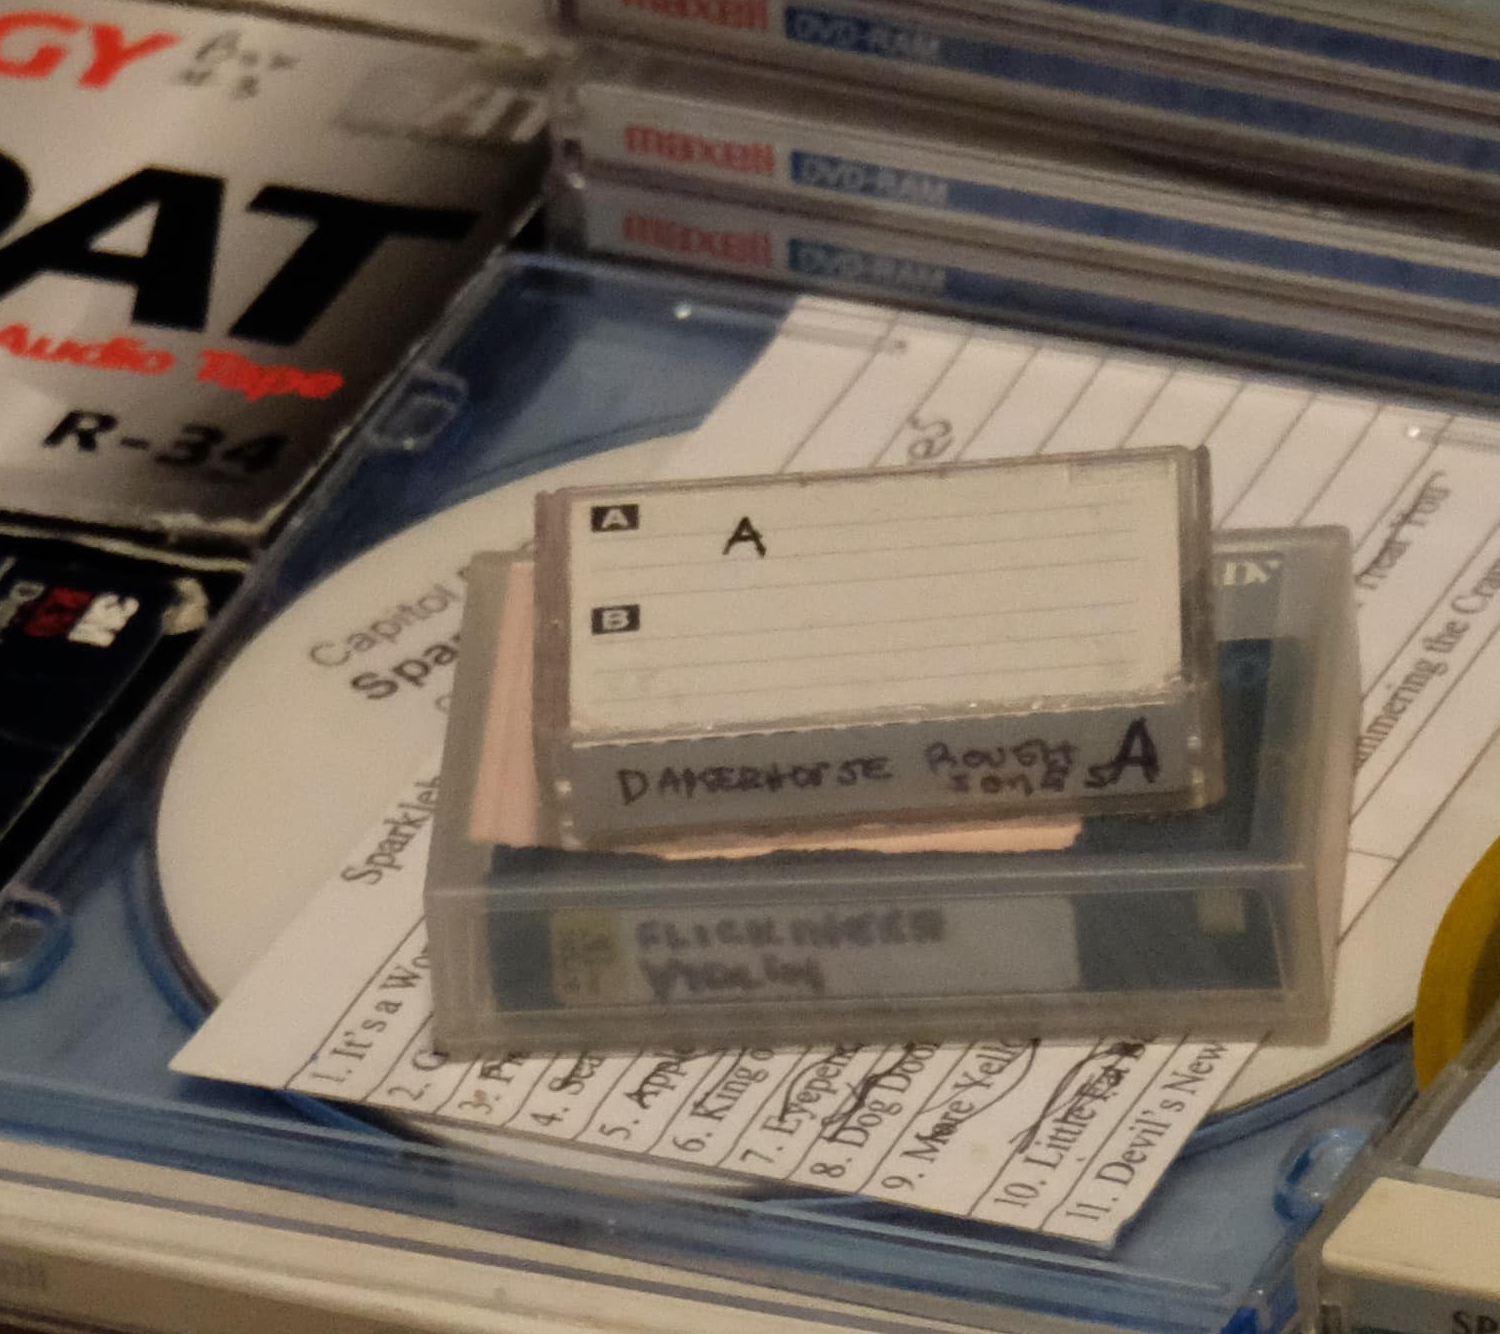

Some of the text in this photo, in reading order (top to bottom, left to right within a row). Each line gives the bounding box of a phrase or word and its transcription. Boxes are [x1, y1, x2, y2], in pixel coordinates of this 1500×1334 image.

[624, 124, 776, 176] maxell
[622, 215, 774, 269] maxell
[193, 347, 345, 403] Tape
[41, 409, 290, 473] R-34
[722, 516, 767, 558] A
[308, 582, 461, 671] Capitol
[1420, 620, 1471, 655] the
[1111, 714, 1162, 785] A
[330, 1017, 388, 1062] It's
[379, 999, 401, 1015] a
[387, 1080, 432, 1103] 2.
[529, 1095, 570, 1127] 4.
[671, 1067, 754, 1154] 6. King
[602, 1117, 640, 1142] 5.
[739, 1143, 782, 1165] 7.
[809, 1099, 902, 1180] 8. Dog
[880, 1095, 977, 1192] 9. More
[994, 1177, 1048, 1211] 10.
[1023, 1093, 1097, 1172] Little
[1064, 1040, 1230, 1224] 11. Devil's New
